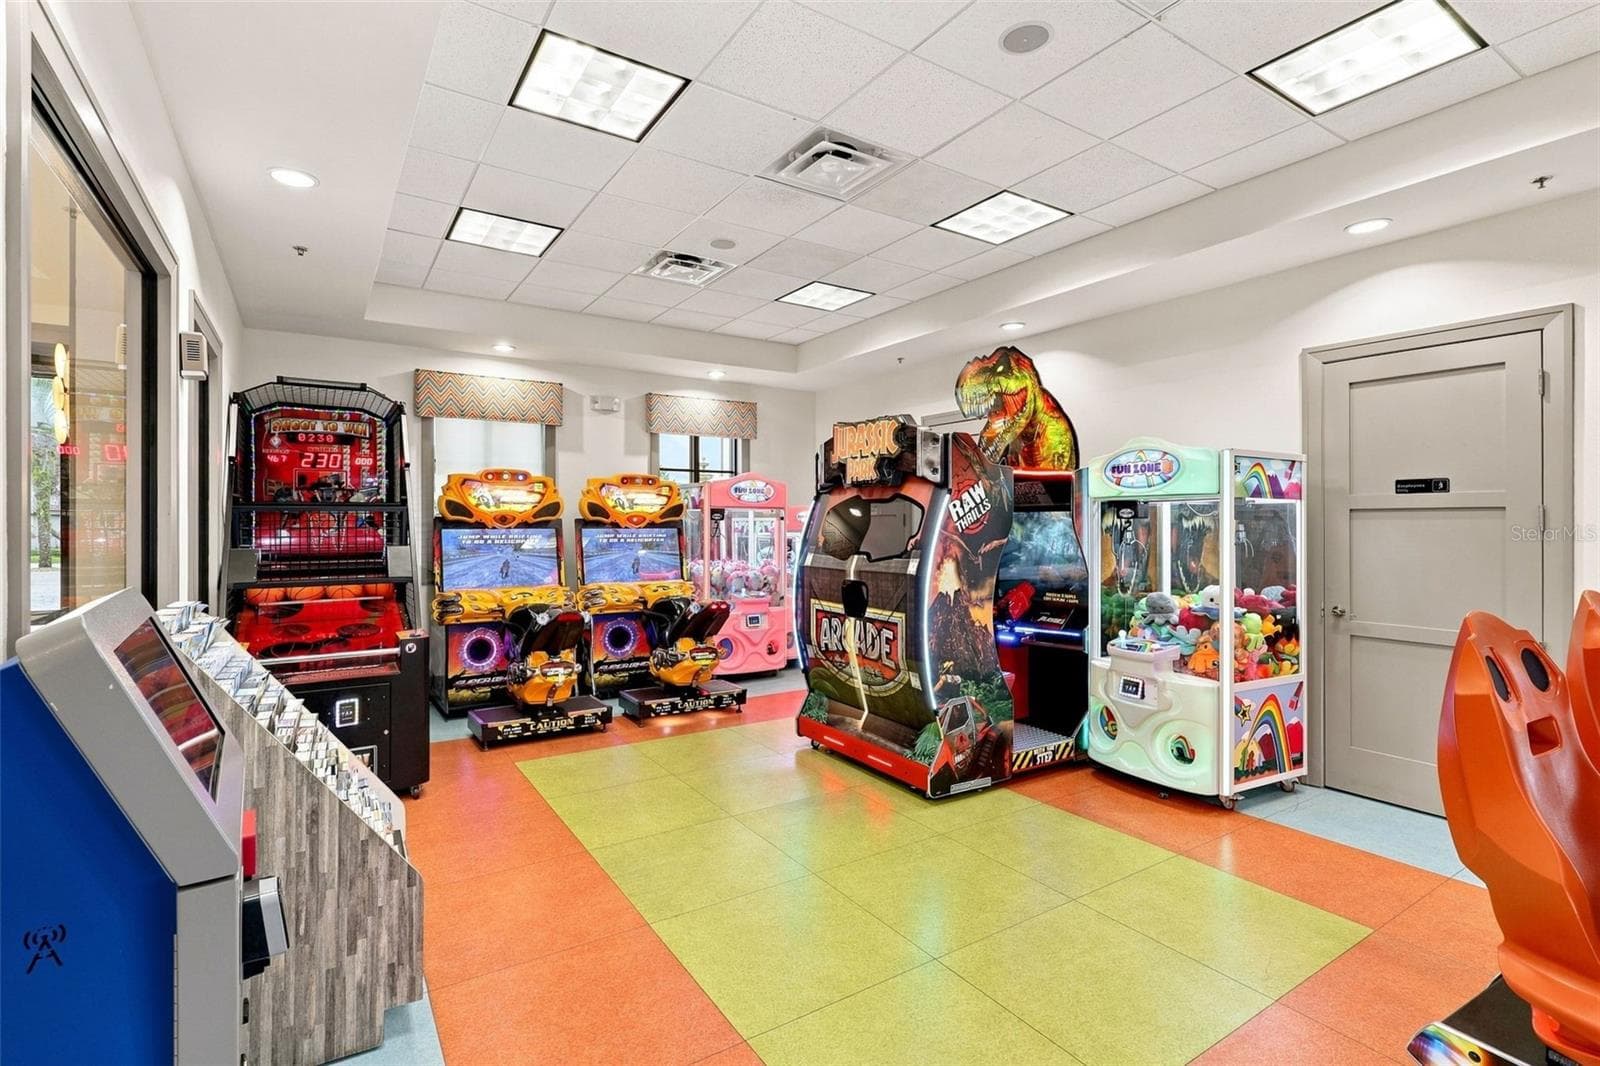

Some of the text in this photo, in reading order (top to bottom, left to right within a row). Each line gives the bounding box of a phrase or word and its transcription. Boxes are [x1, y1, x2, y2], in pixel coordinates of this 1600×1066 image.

[322, 422, 338, 431] TO
[343, 422, 368, 435] WIN
[298, 433, 334, 442] 0230
[831, 420, 898, 464] JURASSIC
[301, 452, 342, 468] 230
[846, 458, 878, 484] PARK
[1111, 463, 1161, 474] FUN ZONE
[948, 480, 986, 522] RAW
[955, 499, 992, 533] THRILLS
[821, 618, 896, 670] ARCADE
[678, 698, 715, 709] CAUTION
[530, 718, 575, 731] CAUTION
